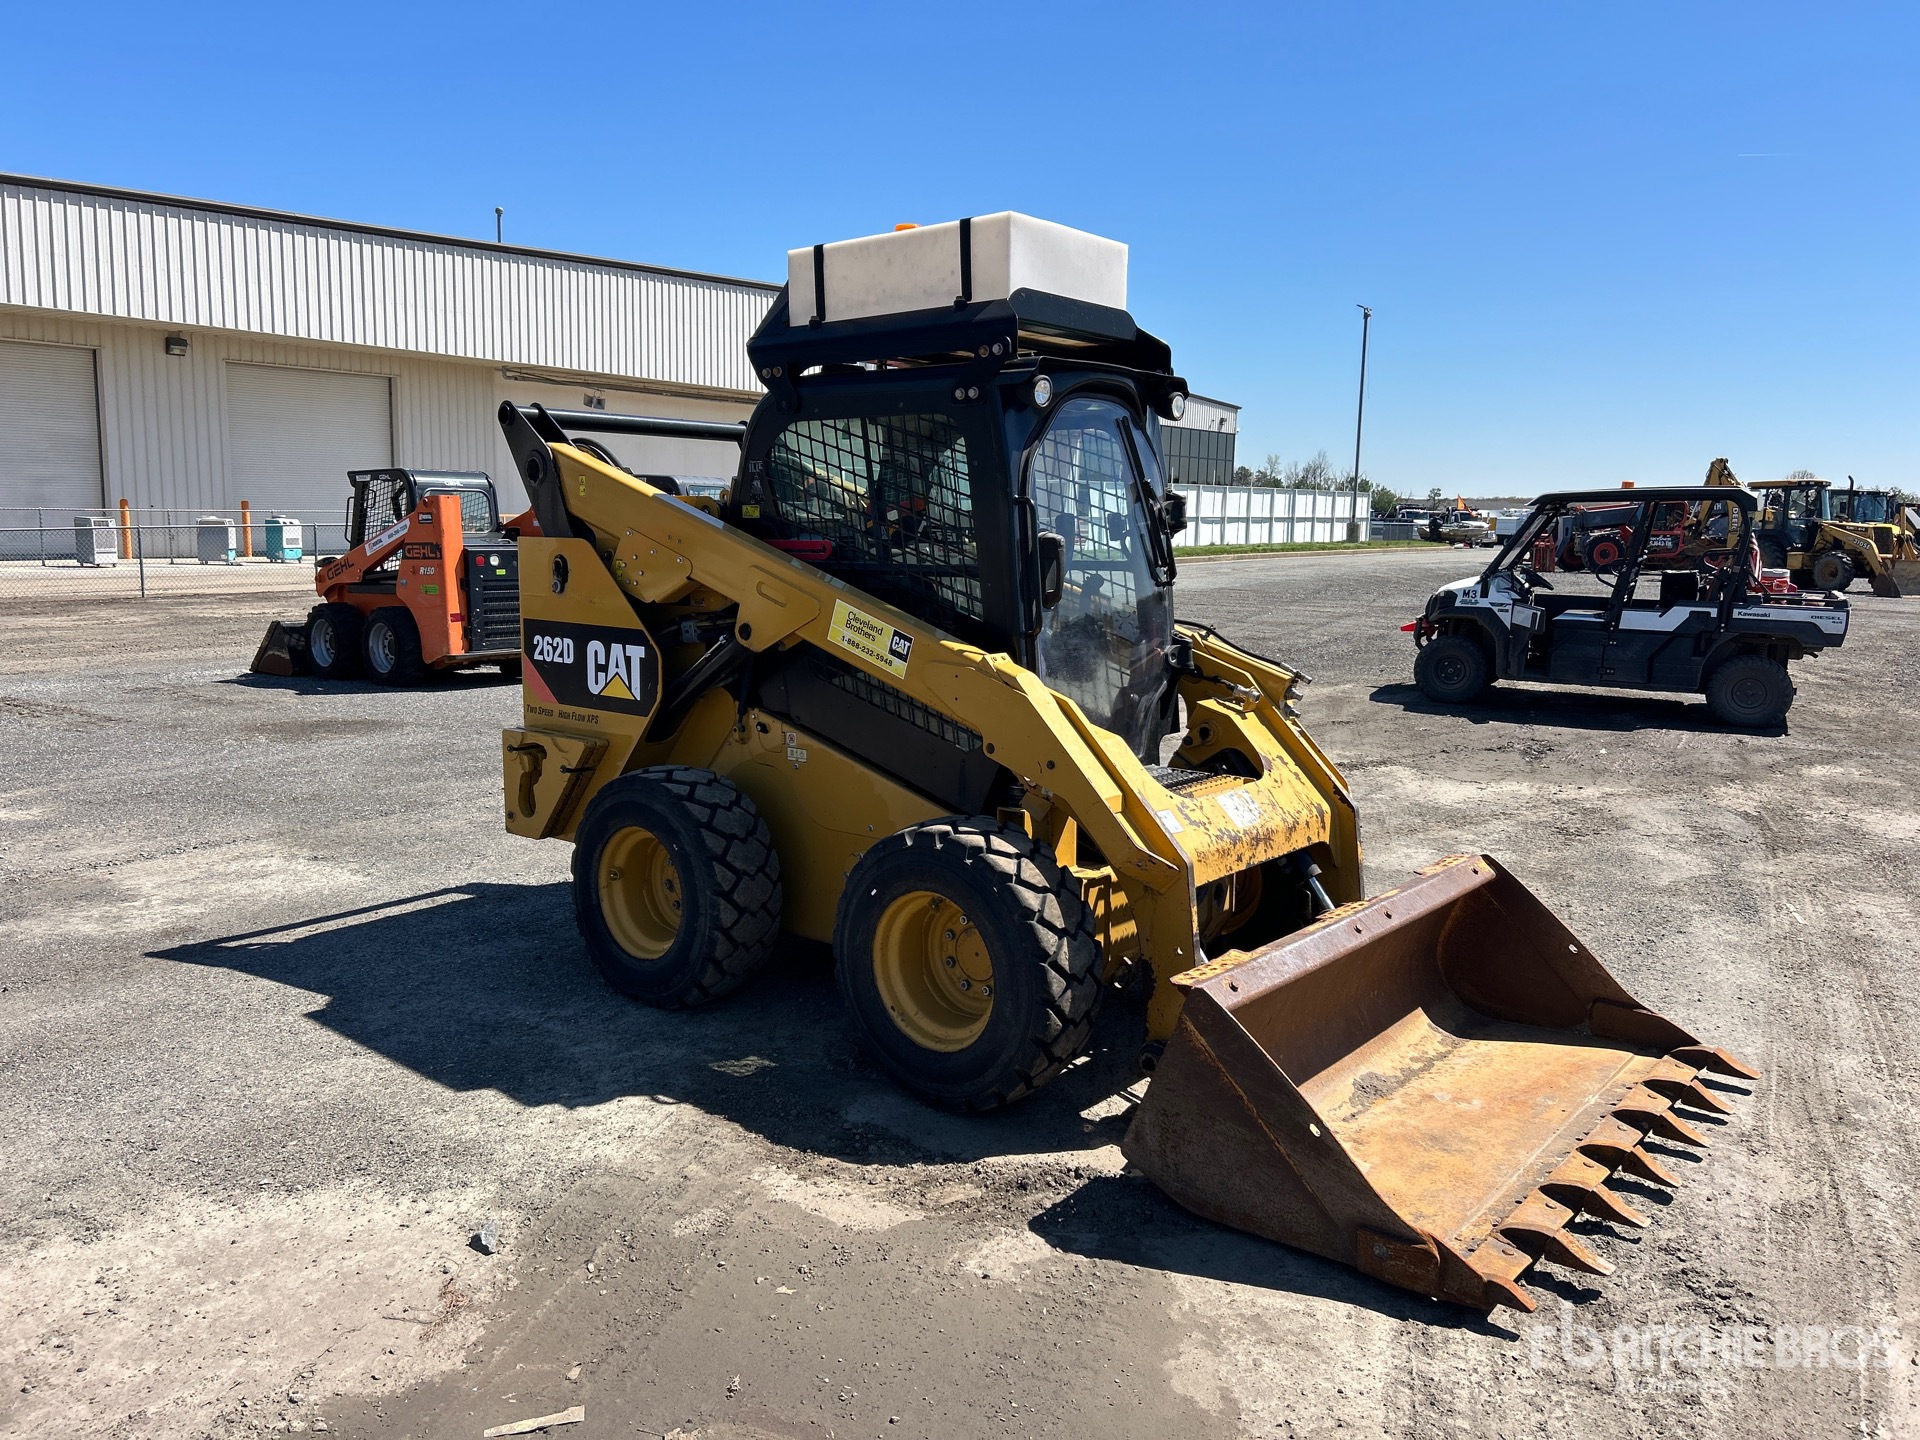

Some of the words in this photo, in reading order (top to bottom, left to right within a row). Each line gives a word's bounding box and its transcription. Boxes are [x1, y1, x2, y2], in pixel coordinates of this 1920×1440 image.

[405, 545, 435, 558] GEHL
[326, 557, 355, 581] GEHL
[419, 566, 435, 575] R150
[1462, 589, 1478, 599] M3
[848, 611, 884, 636] Cleveland
[1737, 610, 1771, 619] Kawasaki
[845, 619, 876, 642] Brothers
[533, 634, 575, 665] 262D
[840, 635, 893, 667] 1-888-232-5948
[891, 635, 912, 655] CAT
[586, 639, 646, 701] CAT
[586, 713, 600, 725] XPS
